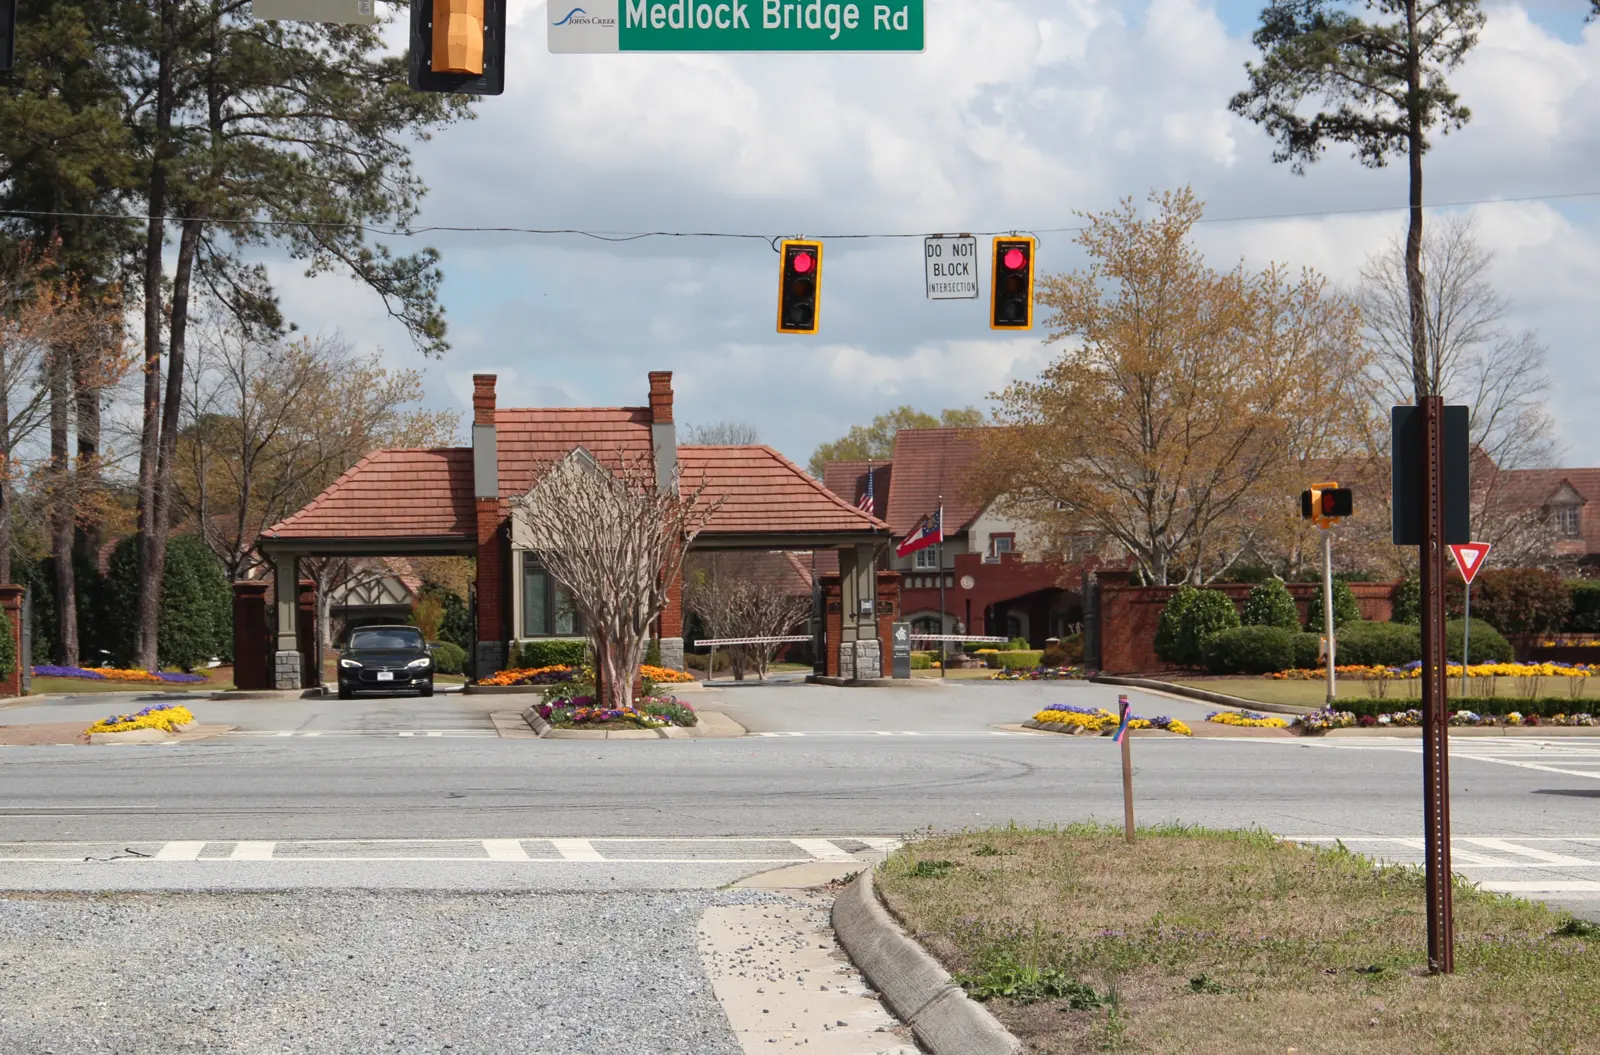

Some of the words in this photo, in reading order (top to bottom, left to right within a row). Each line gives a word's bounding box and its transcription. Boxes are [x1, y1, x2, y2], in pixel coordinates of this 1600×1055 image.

[568, 17, 591, 25] JOHNS
[591, 16, 616, 25] CREEK
[625, 0, 750, 29] Medlock
[762, 0, 860, 40] Bridge
[873, 5, 908, 30] Rd
[927, 244, 942, 258] DO
[952, 243, 974, 257] NOT
[933, 262, 969, 277] BLOCK
[928, 282, 976, 293] INTERSECTION
